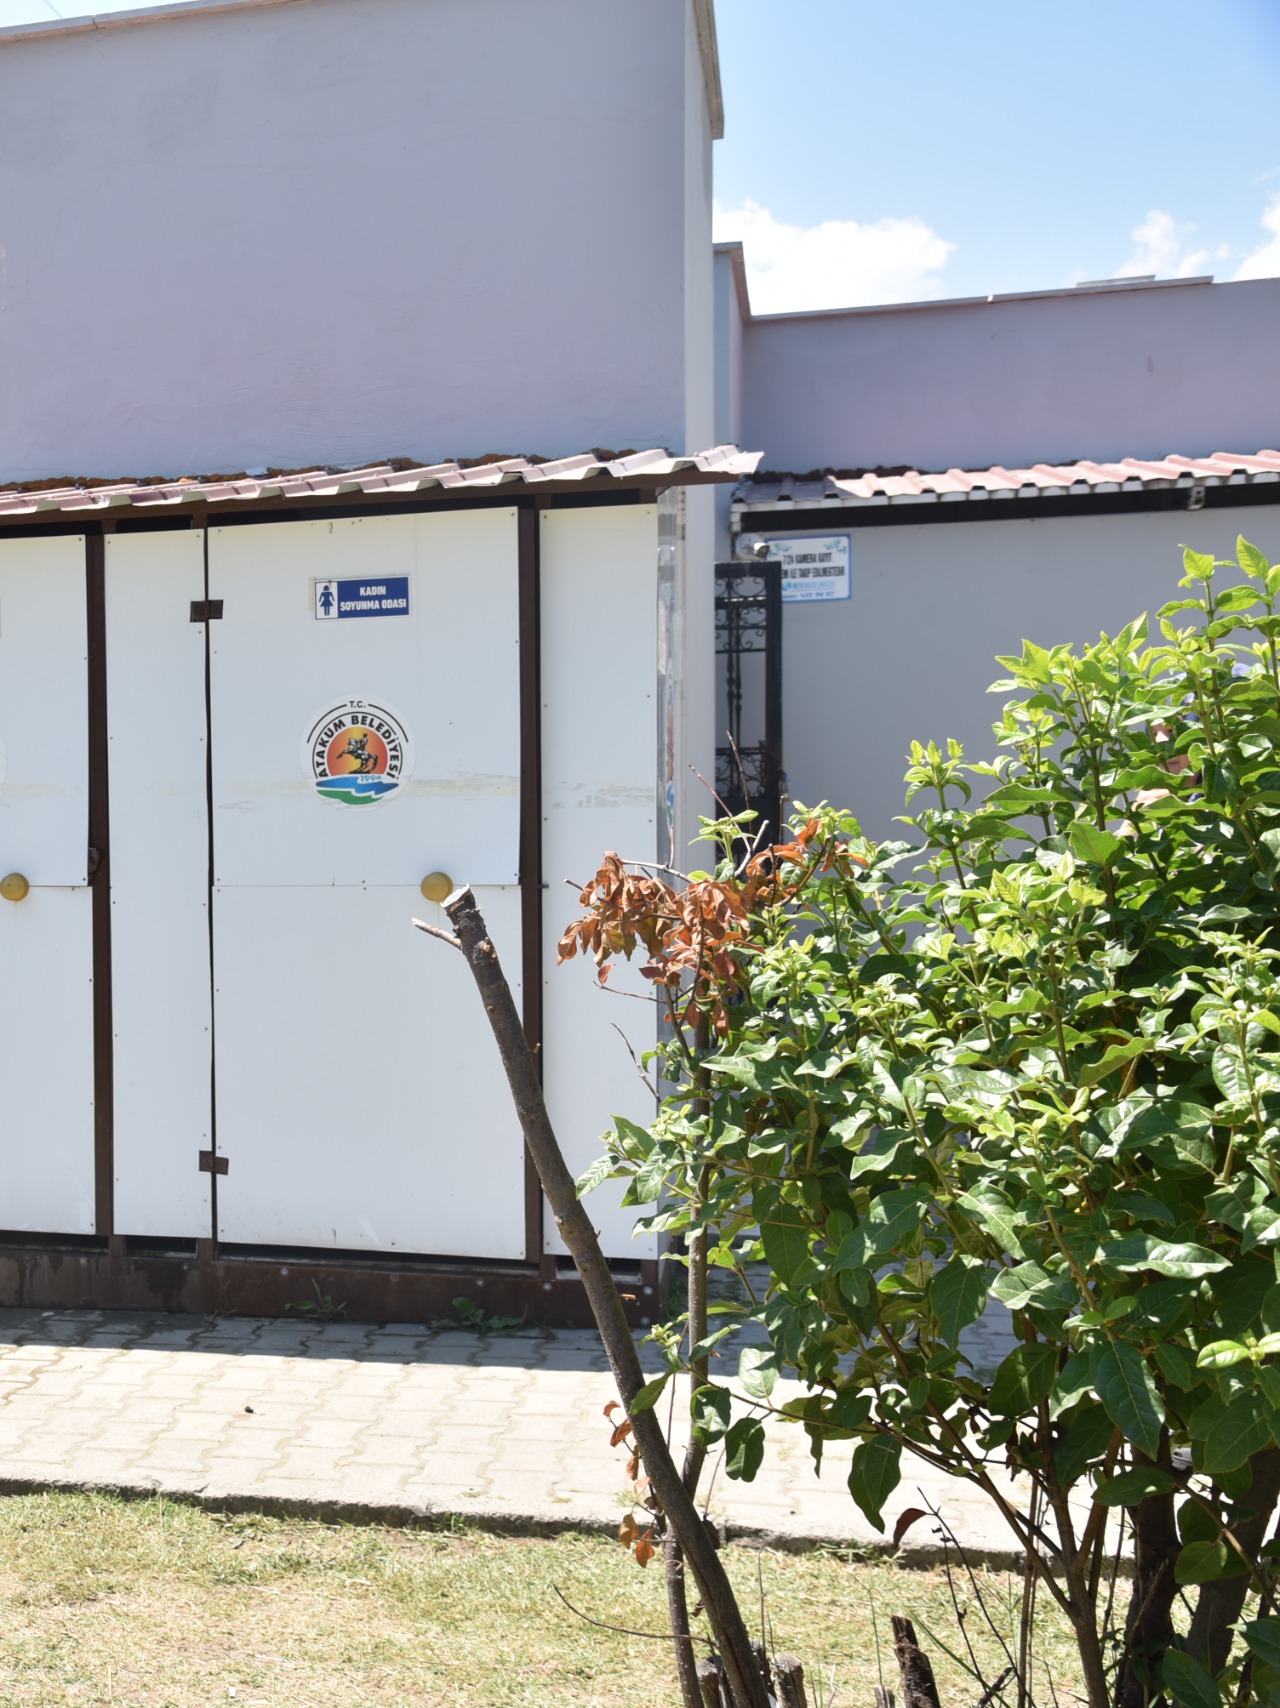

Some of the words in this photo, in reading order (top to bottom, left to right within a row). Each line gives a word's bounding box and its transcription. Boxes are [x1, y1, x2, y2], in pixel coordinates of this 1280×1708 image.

[359, 585, 386, 596] KADIN
[340, 600, 380, 612] SOYUNMA
[381, 598, 406, 609] ODASI
[349, 700, 366, 708] T.C.
[315, 719, 346, 777] ATAKUM
[351, 715, 399, 780] BELEDİYESİ
